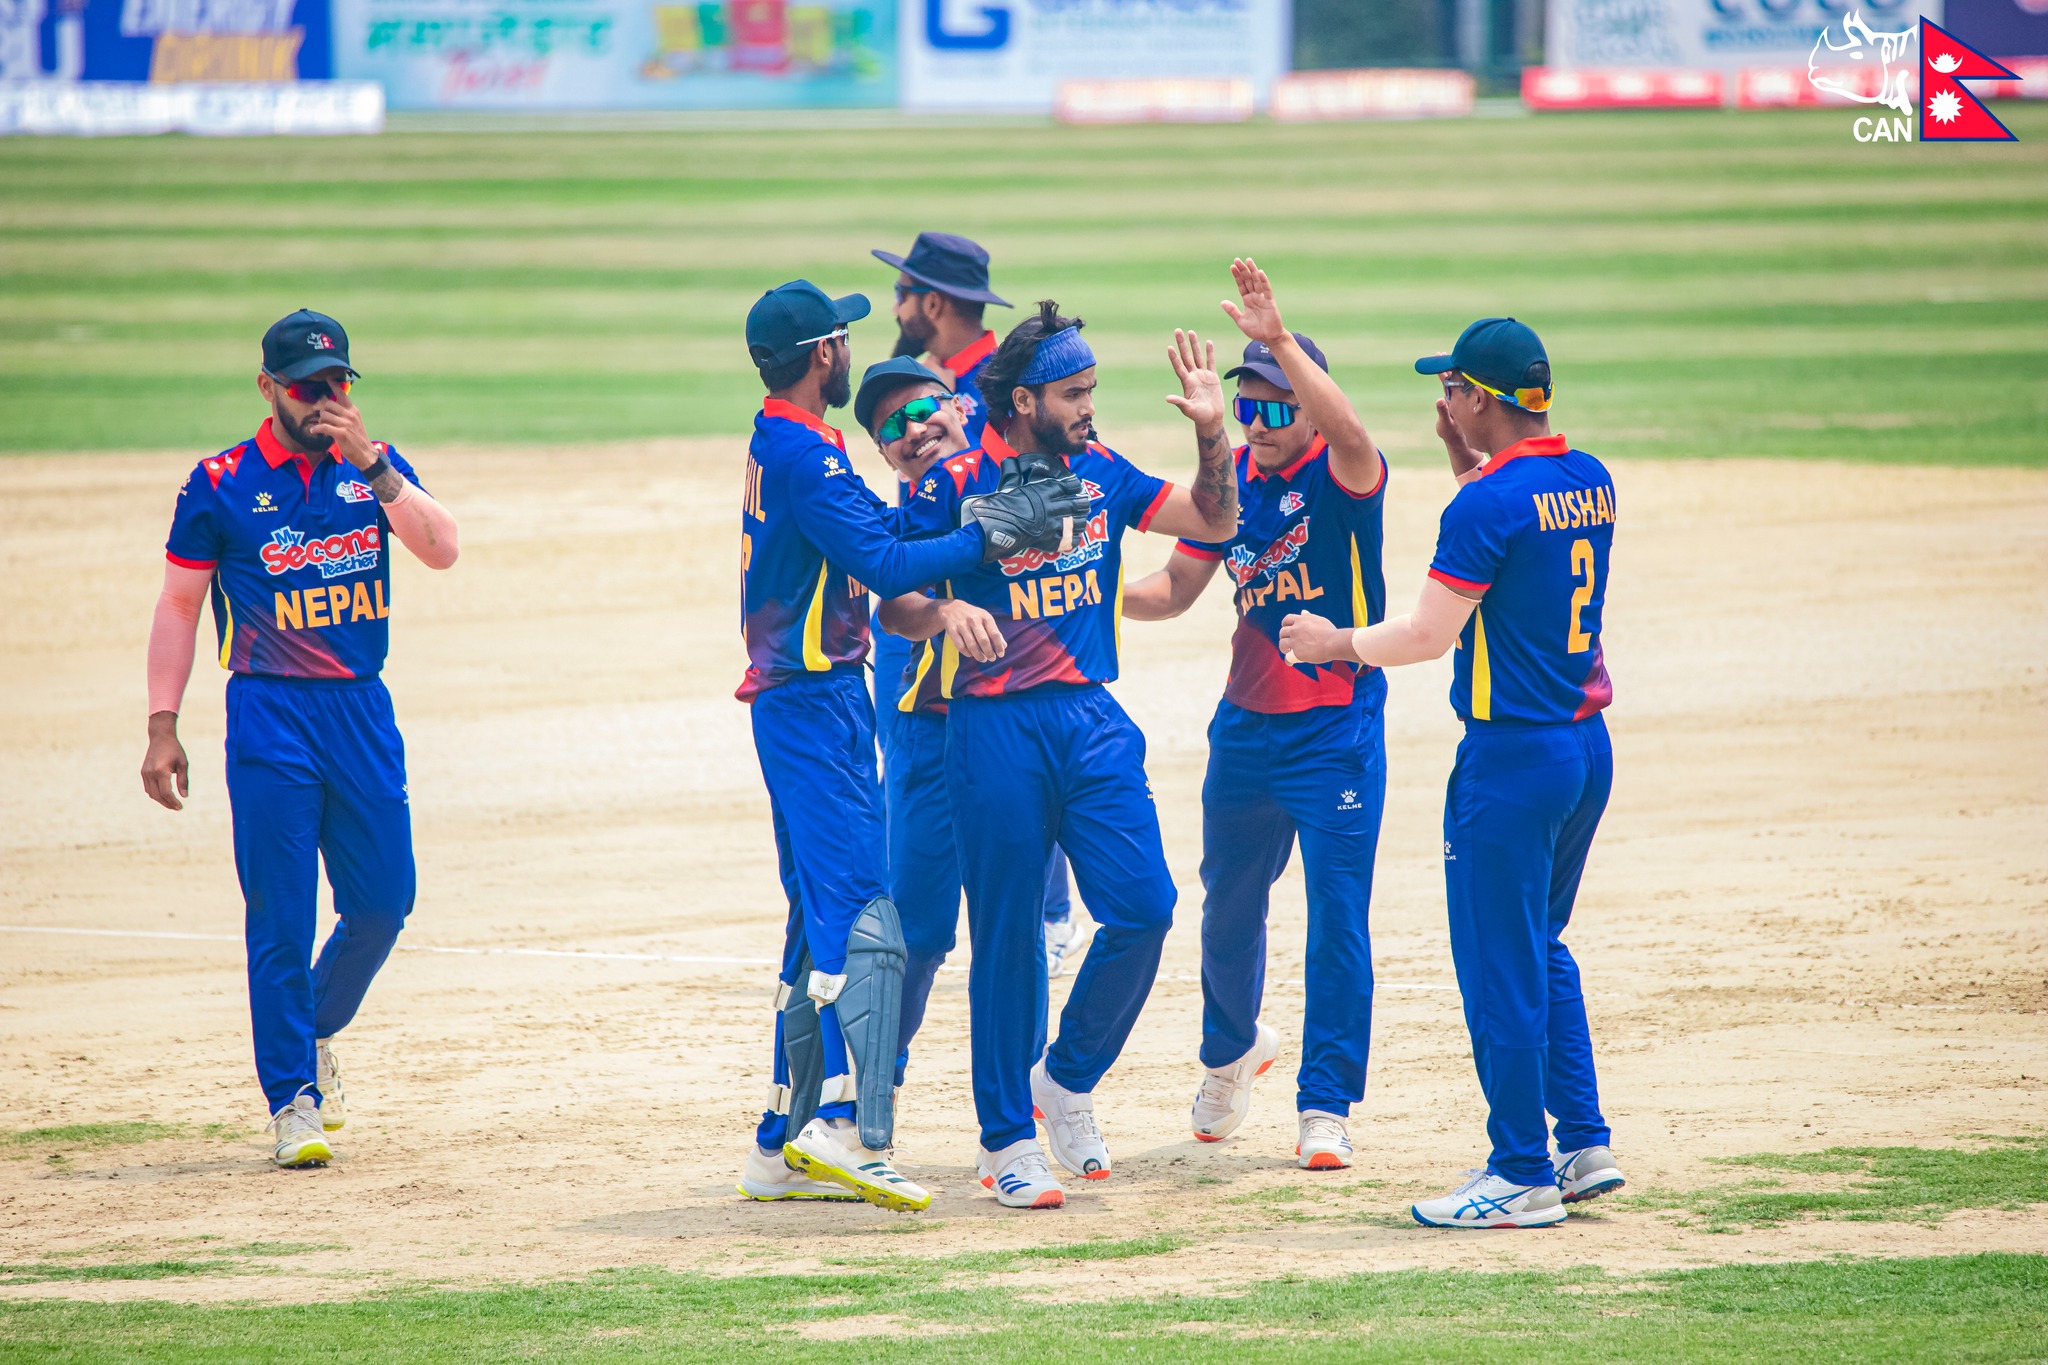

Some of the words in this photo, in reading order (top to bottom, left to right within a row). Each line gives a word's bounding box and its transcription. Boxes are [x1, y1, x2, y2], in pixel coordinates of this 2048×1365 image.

[252, 505, 279, 513] KELME
[271, 526, 304, 547] My
[319, 552, 378, 579] Teacher
[1054, 542, 1103, 573] Teacher
[274, 579, 388, 630] NEPAL
[1567, 538, 1595, 654] 2
[1337, 802, 1363, 811] KELME
